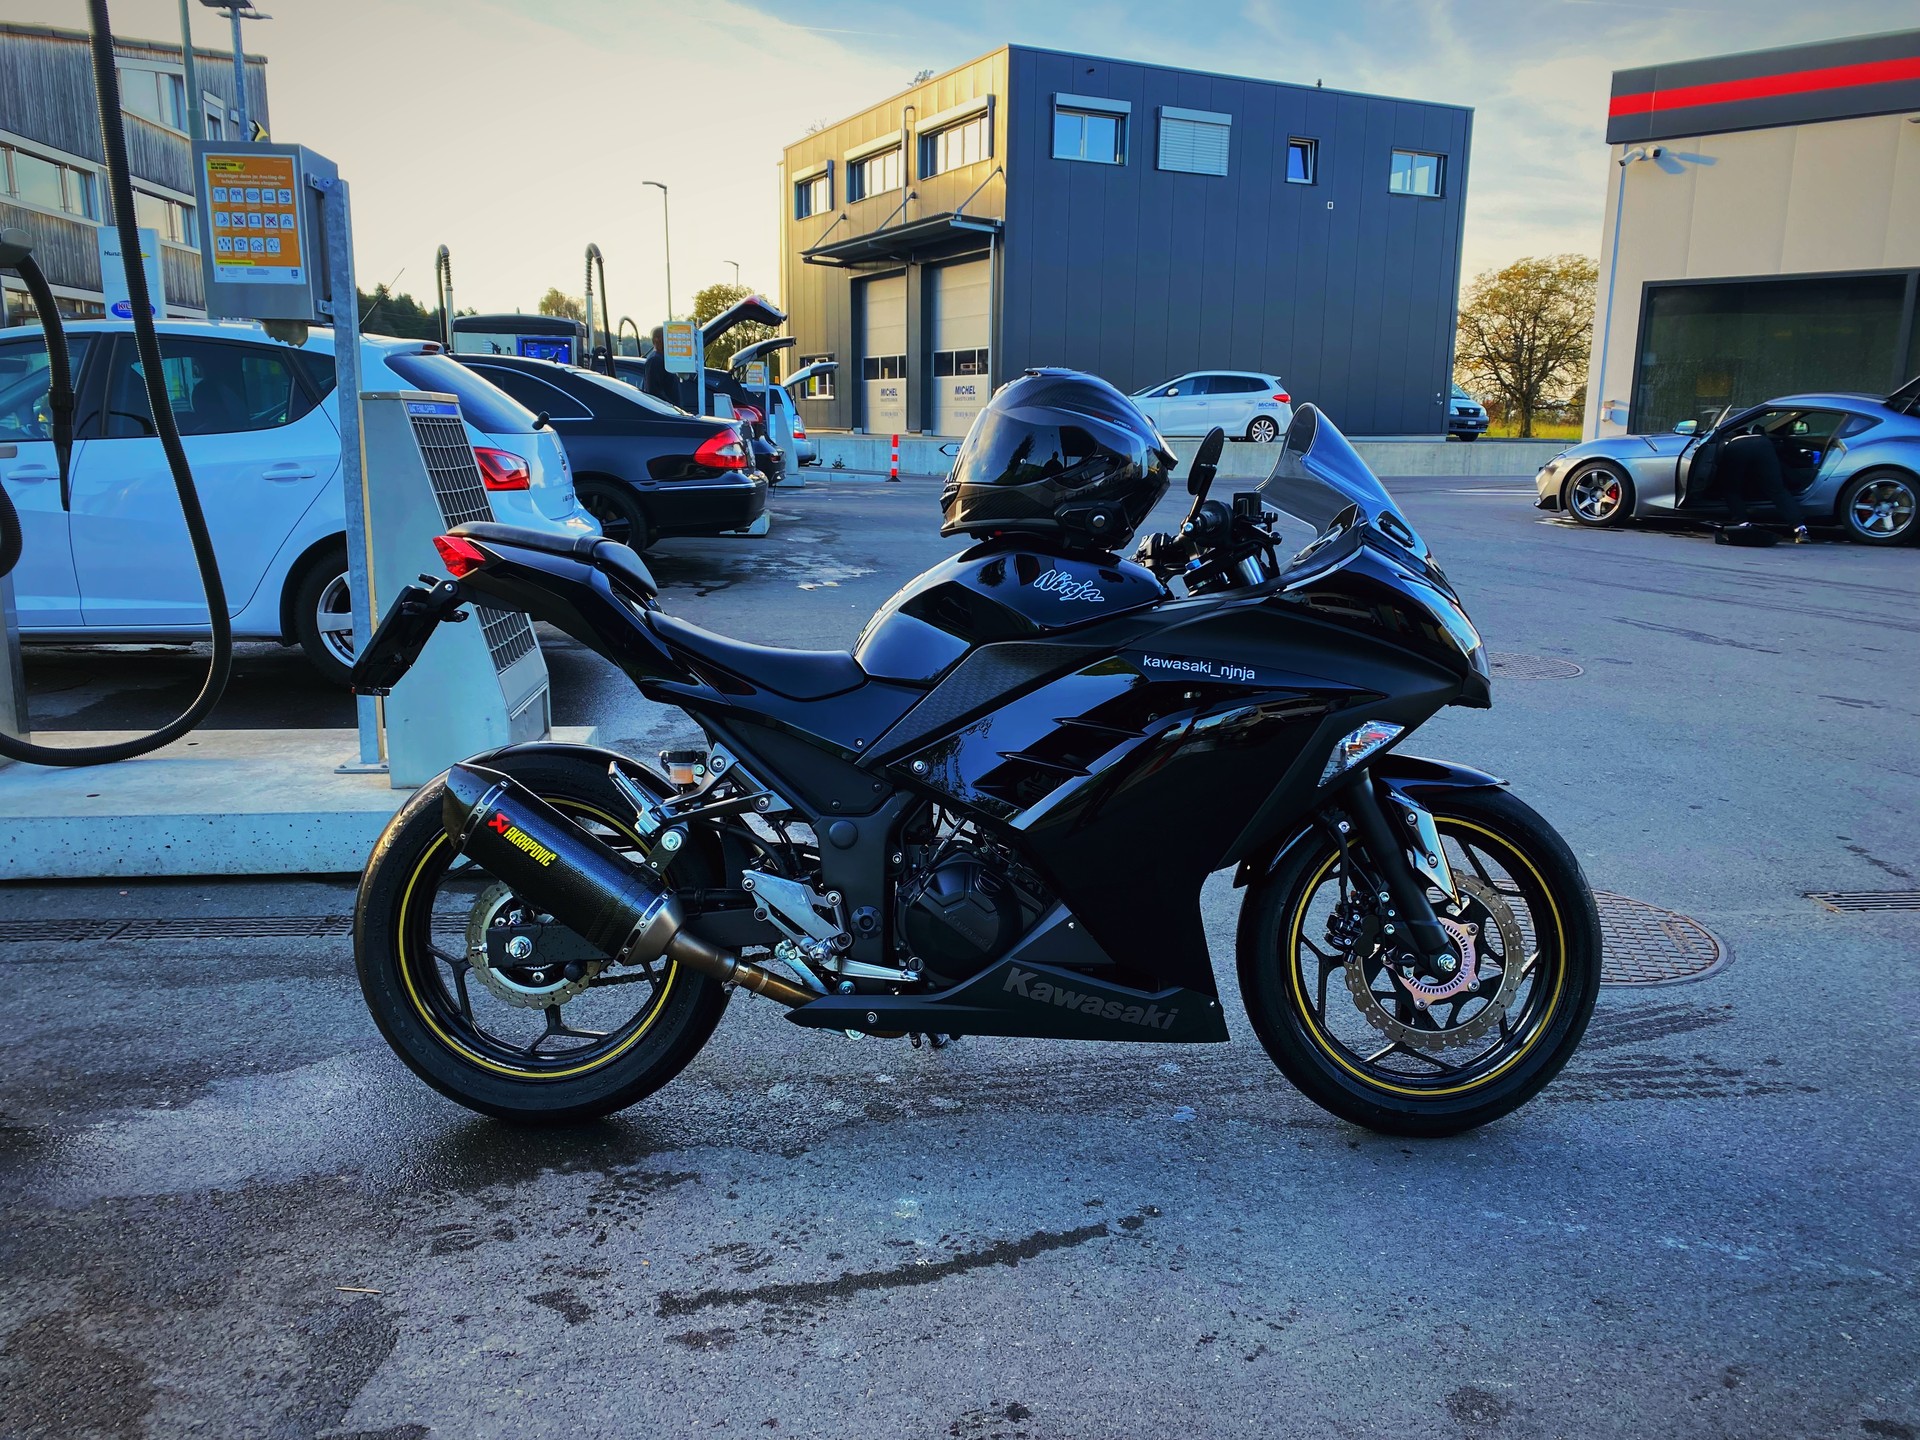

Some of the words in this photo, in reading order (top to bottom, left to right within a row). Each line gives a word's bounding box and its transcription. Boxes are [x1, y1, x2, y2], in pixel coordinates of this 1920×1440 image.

[881, 388, 898, 396] MICHEL
[955, 385, 976, 395] MICHEL
[1033, 569, 1105, 602] Ninja
[1002, 967, 1179, 1030] Kawasaki
